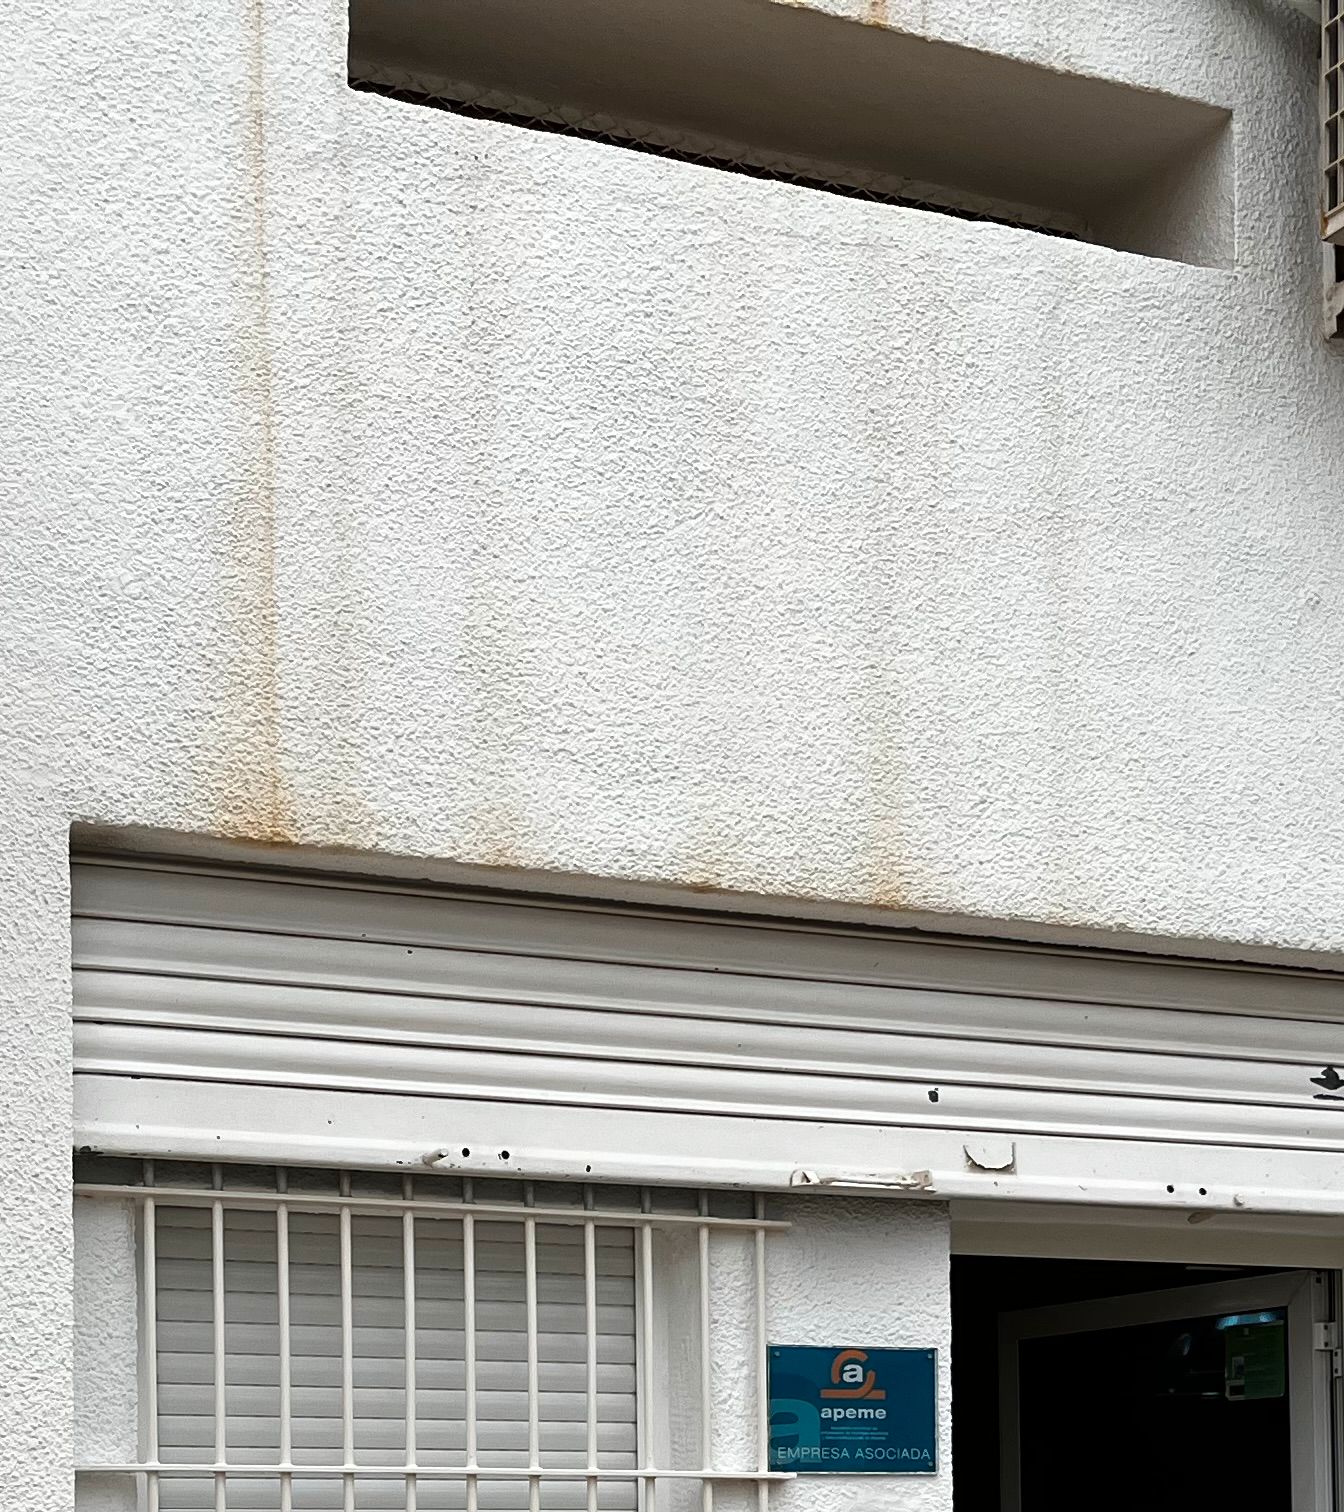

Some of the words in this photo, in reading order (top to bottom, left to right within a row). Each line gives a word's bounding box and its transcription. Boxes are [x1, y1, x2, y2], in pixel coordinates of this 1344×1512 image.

[842, 1364, 864, 1383] a
[820, 1407, 887, 1422] apeme
[777, 1446, 851, 1460] EMPRESA
[854, 1447, 931, 1461] ASOCIADA
